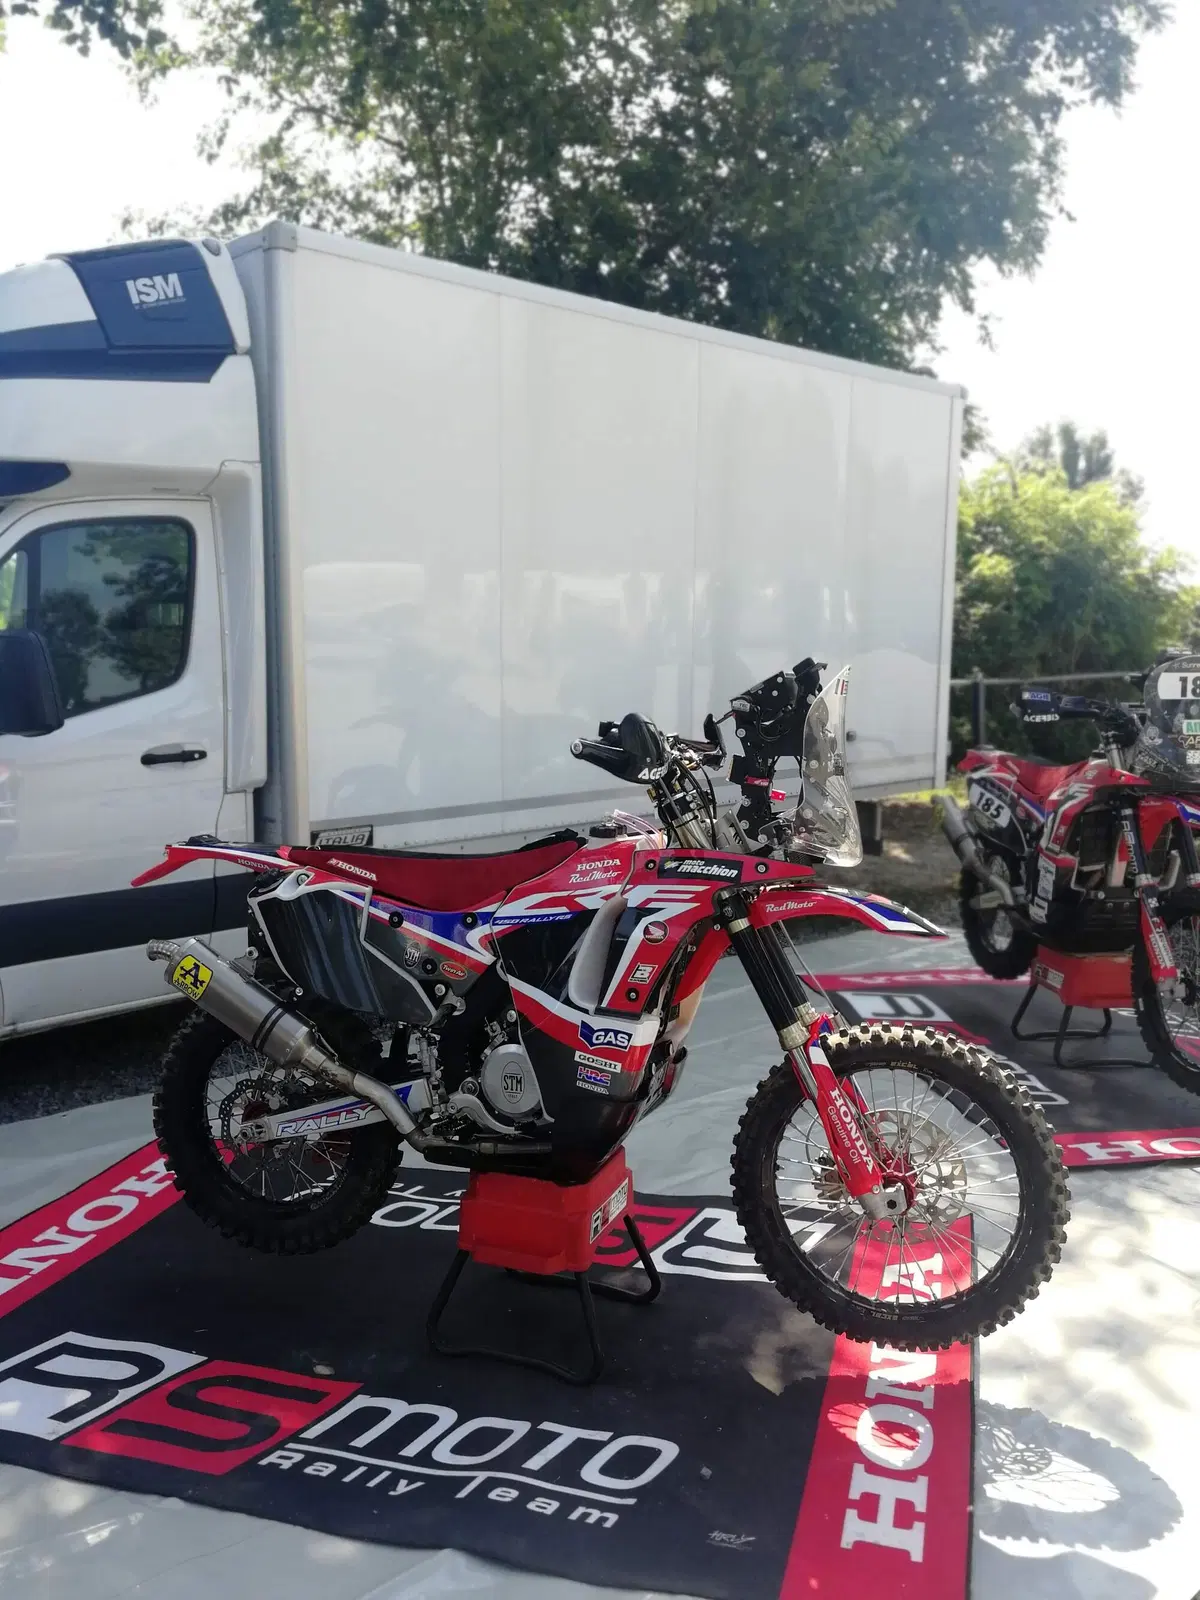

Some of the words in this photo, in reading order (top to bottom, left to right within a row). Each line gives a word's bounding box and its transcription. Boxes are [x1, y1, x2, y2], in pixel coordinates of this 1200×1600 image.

[126, 273, 183, 304] ISM
[976, 792, 1005, 819] 185
[237, 859, 271, 870] HONDA
[336, 860, 377, 881] HONDA
[576, 858, 621, 872] HONDA
[677, 864, 739, 879] macchion
[405, 948, 420, 962] STM
[174, 978, 200, 998] ARROW
[592, 1031, 629, 1047] GAS
[578, 1054, 618, 1070] GOSHI
[503, 1074, 523, 1092] STM
[576, 1080, 609, 1095] HONDA
[275, 1104, 377, 1137] RALLY
[829, 1087, 874, 1174] HONDA
[827, 1105, 851, 1149] Genuine
[849, 1148, 862, 1165] Oil
[0, 1157, 178, 1295] HON
[839, 1252, 945, 1563] HONA
[258, 1449, 426, 1497] Rally
[454, 1474, 620, 1529] Team
